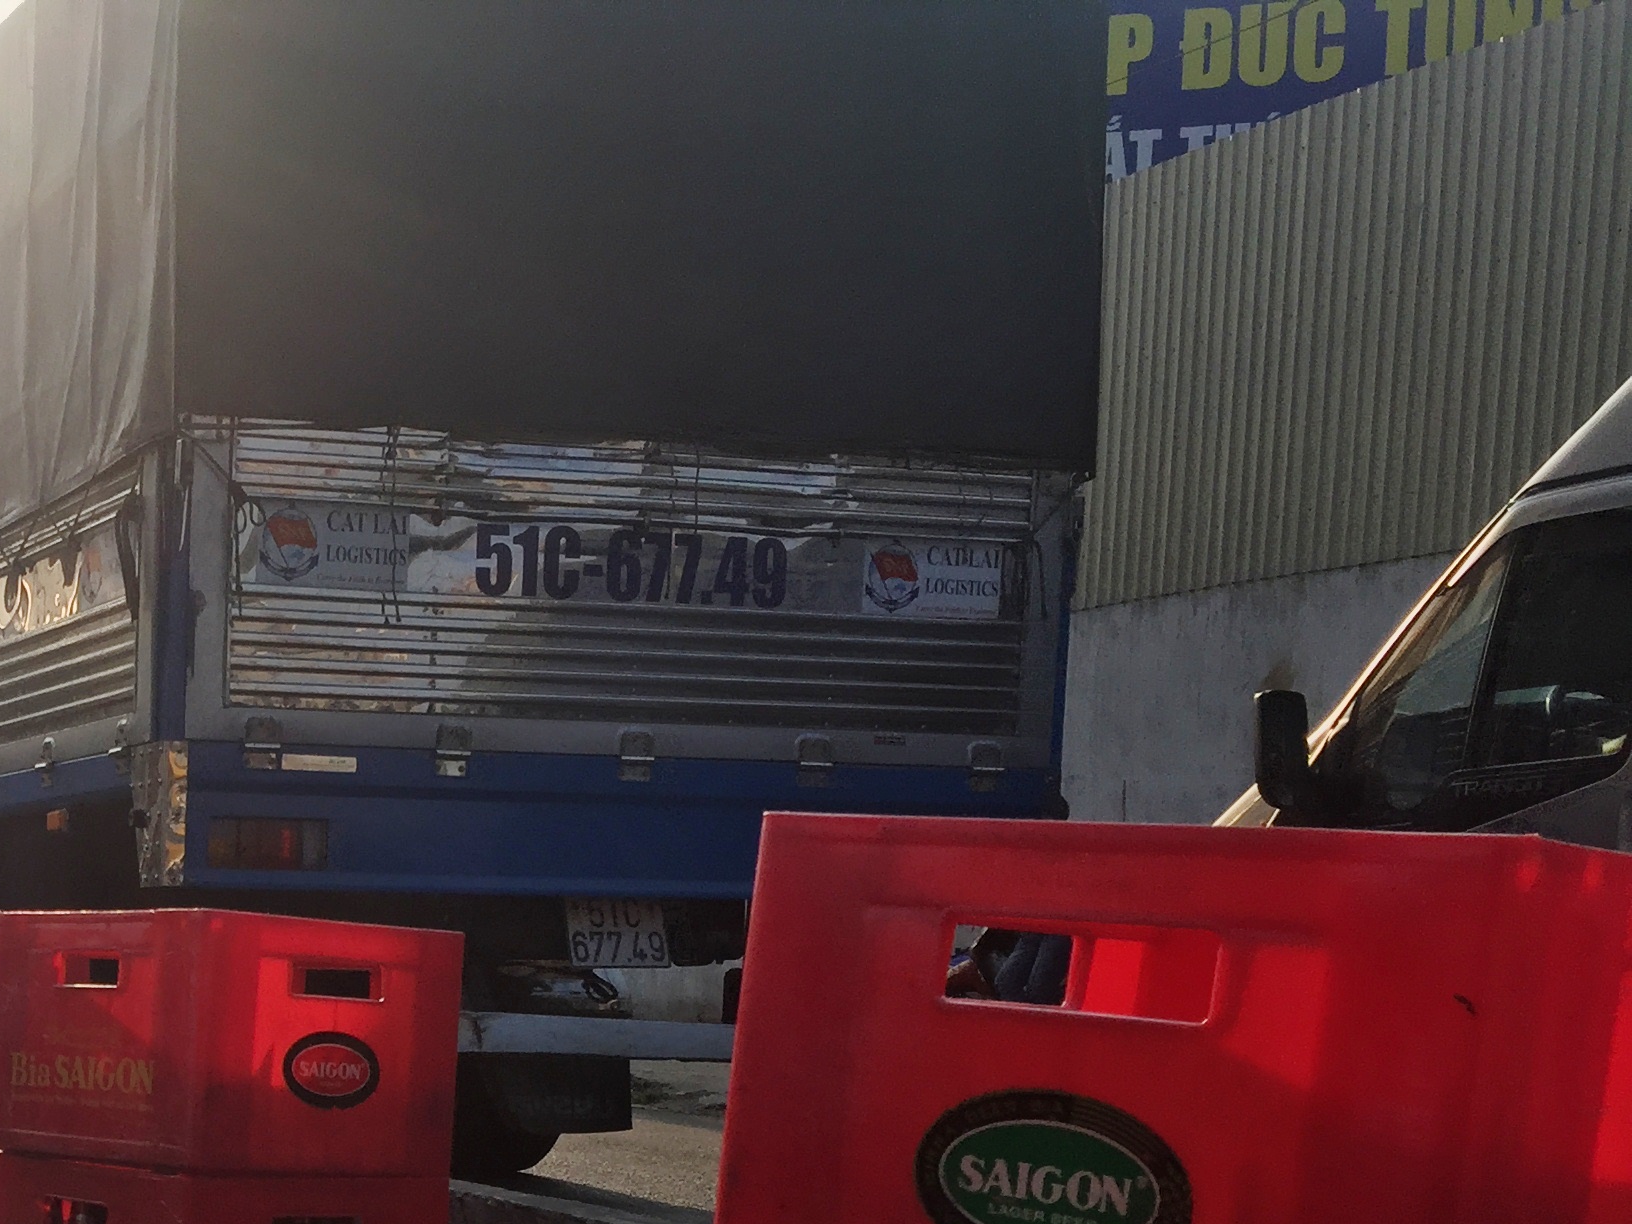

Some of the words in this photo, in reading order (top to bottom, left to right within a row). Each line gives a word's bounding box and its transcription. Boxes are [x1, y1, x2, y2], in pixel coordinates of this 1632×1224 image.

[326, 509, 368, 533] CAT
[372, 512, 407, 536] LAI
[325, 544, 407, 567] LOGISTICS
[475, 522, 788, 608] 51C-677.49
[927, 545, 965, 567] CAT
[925, 577, 999, 598] LOGISTICS
[571, 930, 666, 963] 677.49
[9, 1051, 51, 1088] Bia
[54, 1054, 155, 1095] SAIGON
[298, 1060, 362, 1081] SAIGON
[957, 1153, 1133, 1217] SAIGON
[987, 1202, 1045, 1224] LAGER
